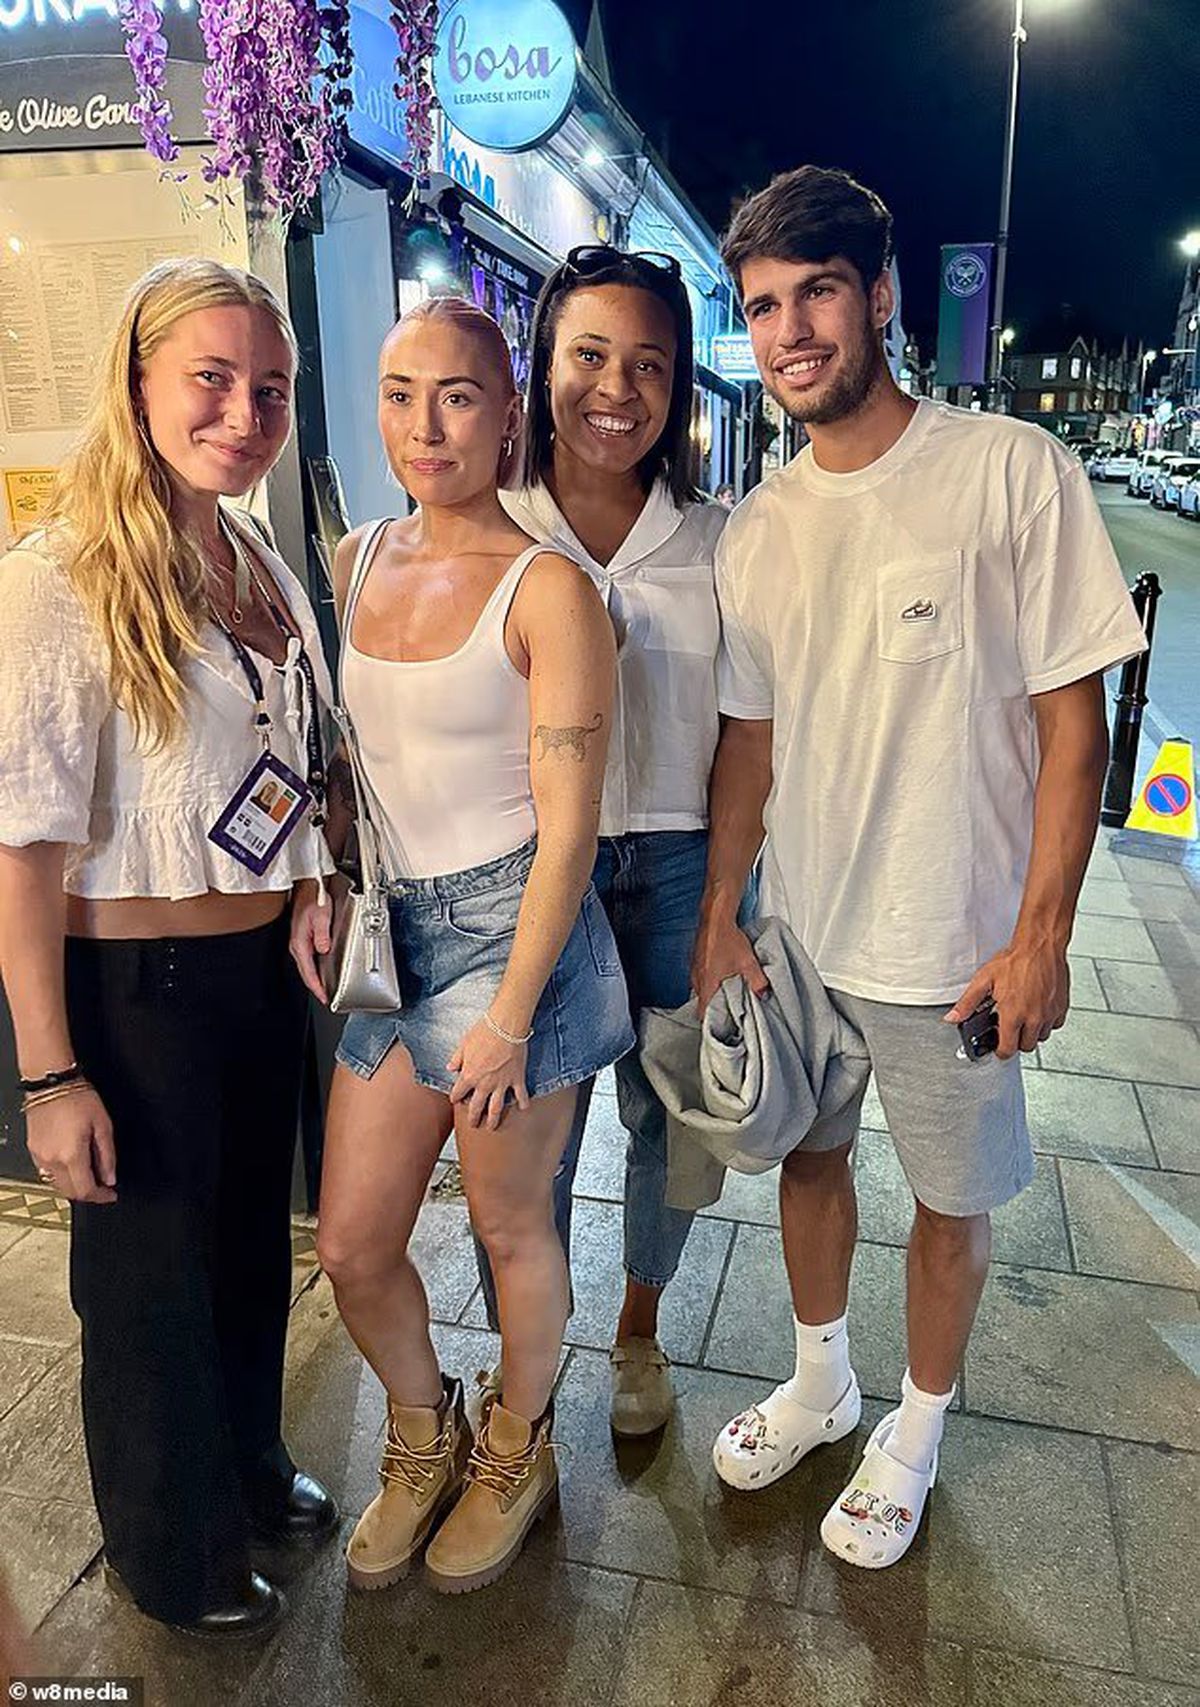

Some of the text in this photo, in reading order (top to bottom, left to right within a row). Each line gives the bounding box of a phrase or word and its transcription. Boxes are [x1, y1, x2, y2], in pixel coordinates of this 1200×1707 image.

[448, 14, 562, 83] bosa
[453, 88, 551, 105] LEBANESE KITCHEN
[17, 97, 83, 134] Olive
